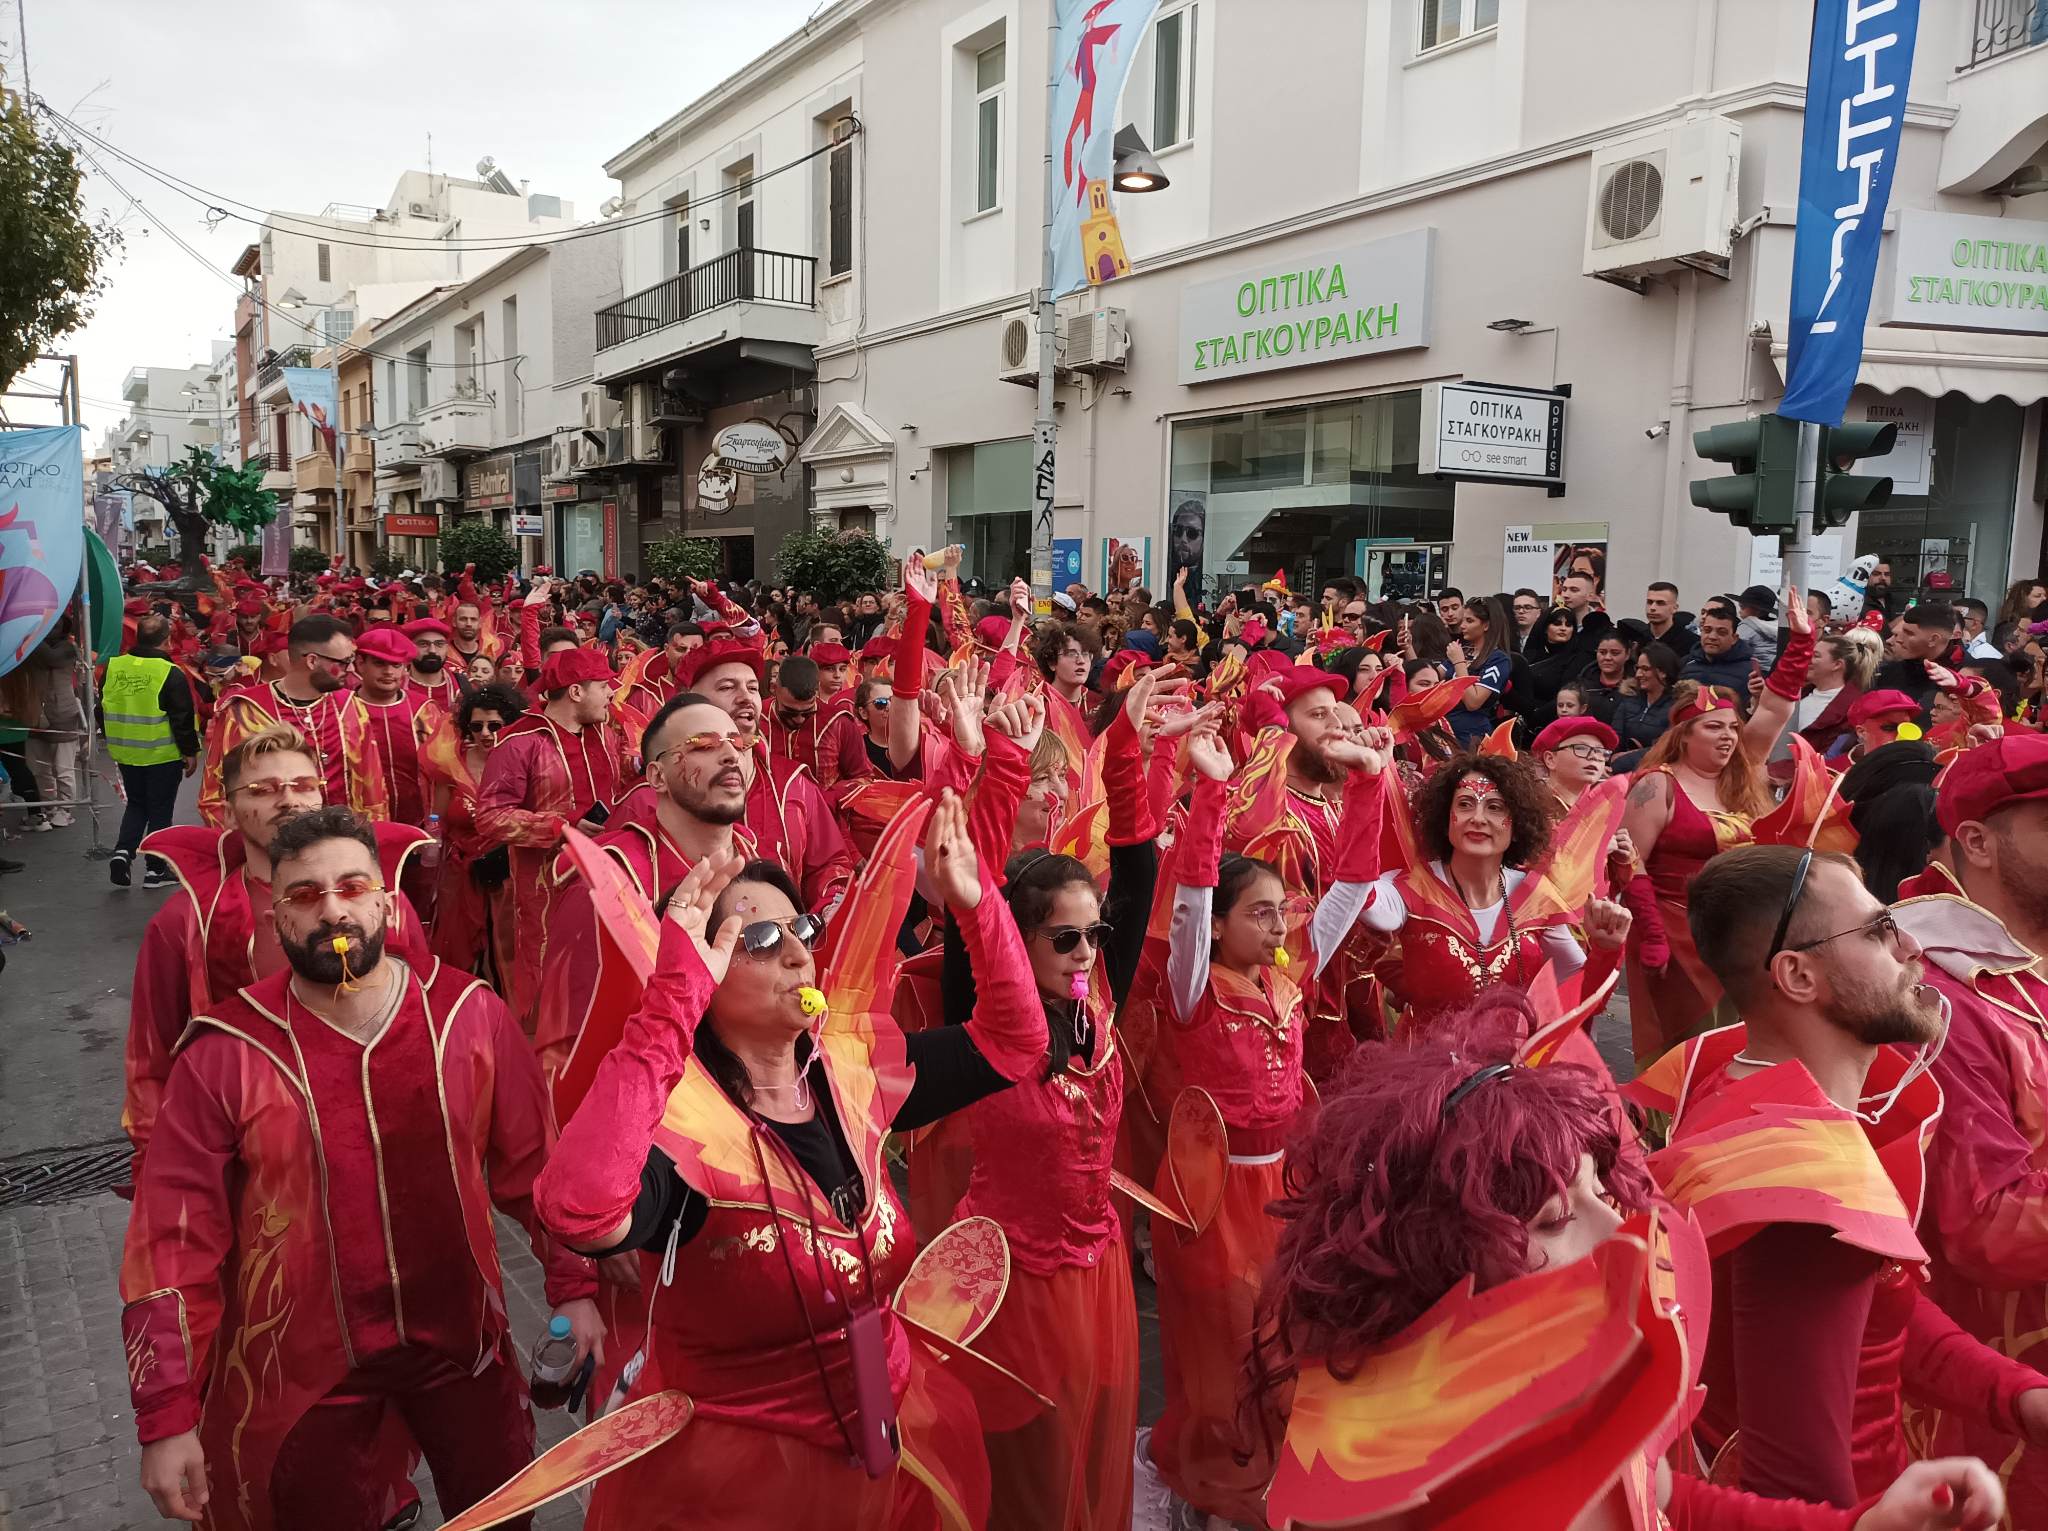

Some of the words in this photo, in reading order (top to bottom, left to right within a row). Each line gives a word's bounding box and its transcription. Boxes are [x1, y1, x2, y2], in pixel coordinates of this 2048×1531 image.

[1236, 263, 1348, 318] ΟΠΤΙΚΑ
[1194, 302, 1400, 370] ΣΤΑΓΚΟΥΡΑΚΗ
[1470, 400, 1523, 420] ΟΠΤΙΚΑ
[1448, 420, 1541, 443] ΣΤΑΓΚΟΥΡΑΚΗ
[1549, 405, 1560, 471] OPTICS
[1486, 453, 1501, 463] see
[1502, 455, 1528, 466] smart
[480, 468, 510, 497] Admiral
[1507, 532, 1530, 542] NEW
[1506, 544, 1548, 554] ARRIVALS
